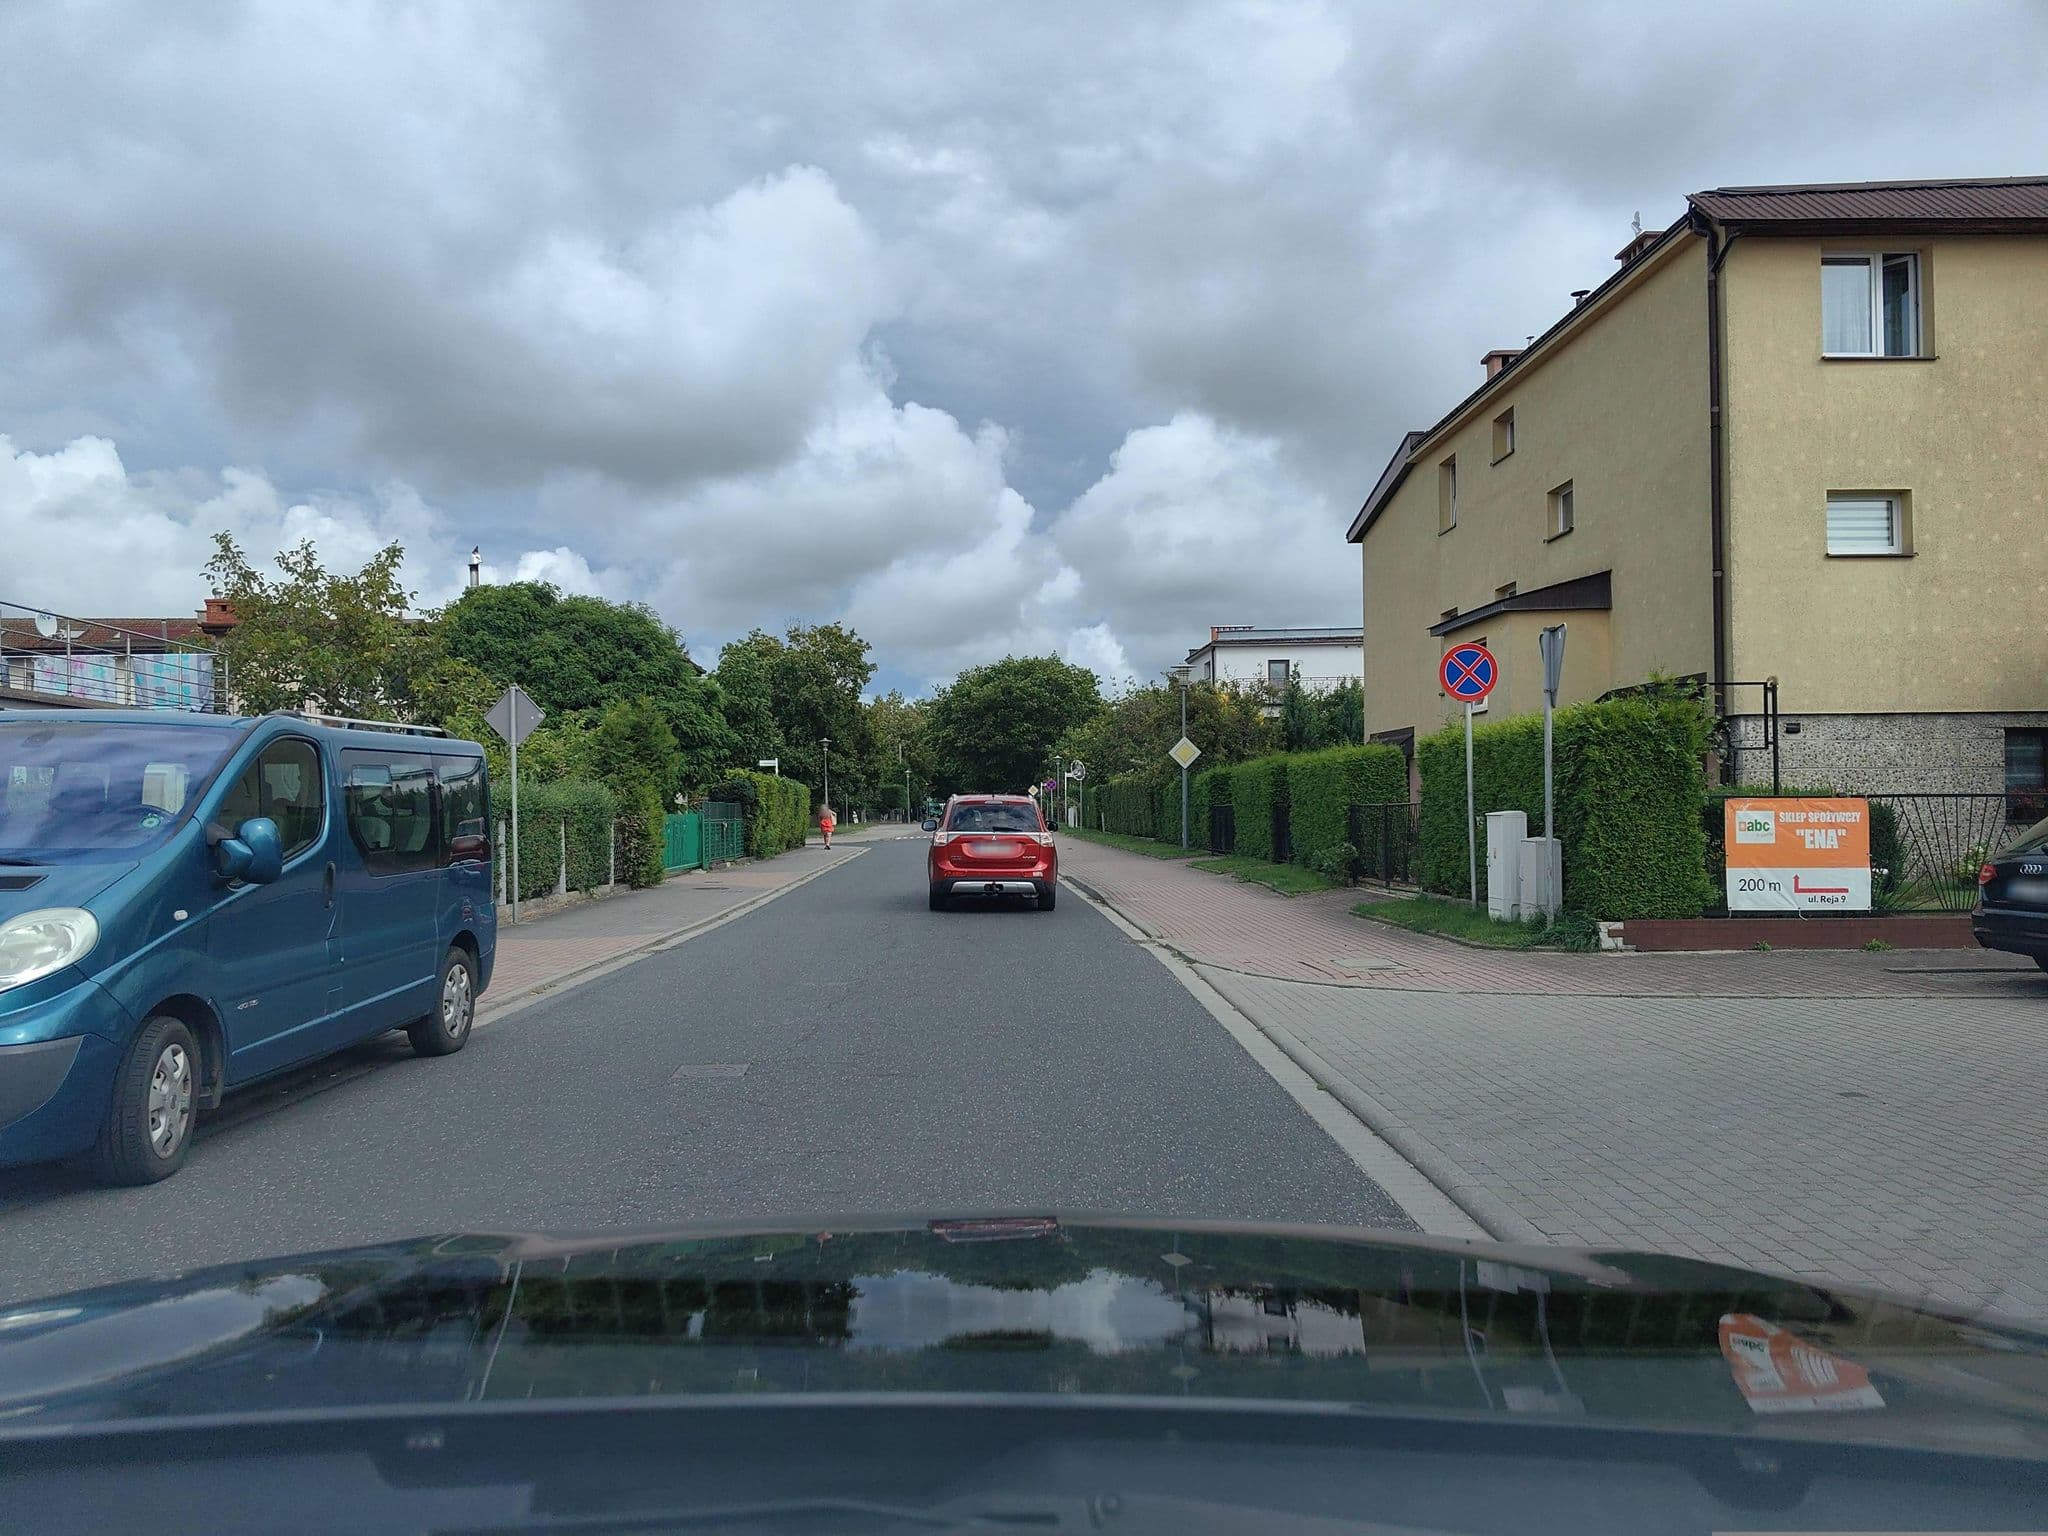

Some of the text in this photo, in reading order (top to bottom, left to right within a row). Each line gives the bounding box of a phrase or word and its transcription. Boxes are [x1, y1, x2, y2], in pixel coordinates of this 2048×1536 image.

[1780, 810, 1861, 823] SKLEP SPOŻYWCZY
[1747, 819, 1770, 832] abc
[1796, 829, 1847, 849] "ENA"
[1738, 879, 1781, 892] 200 m
[1808, 895, 1847, 905] ul. Reja 9
